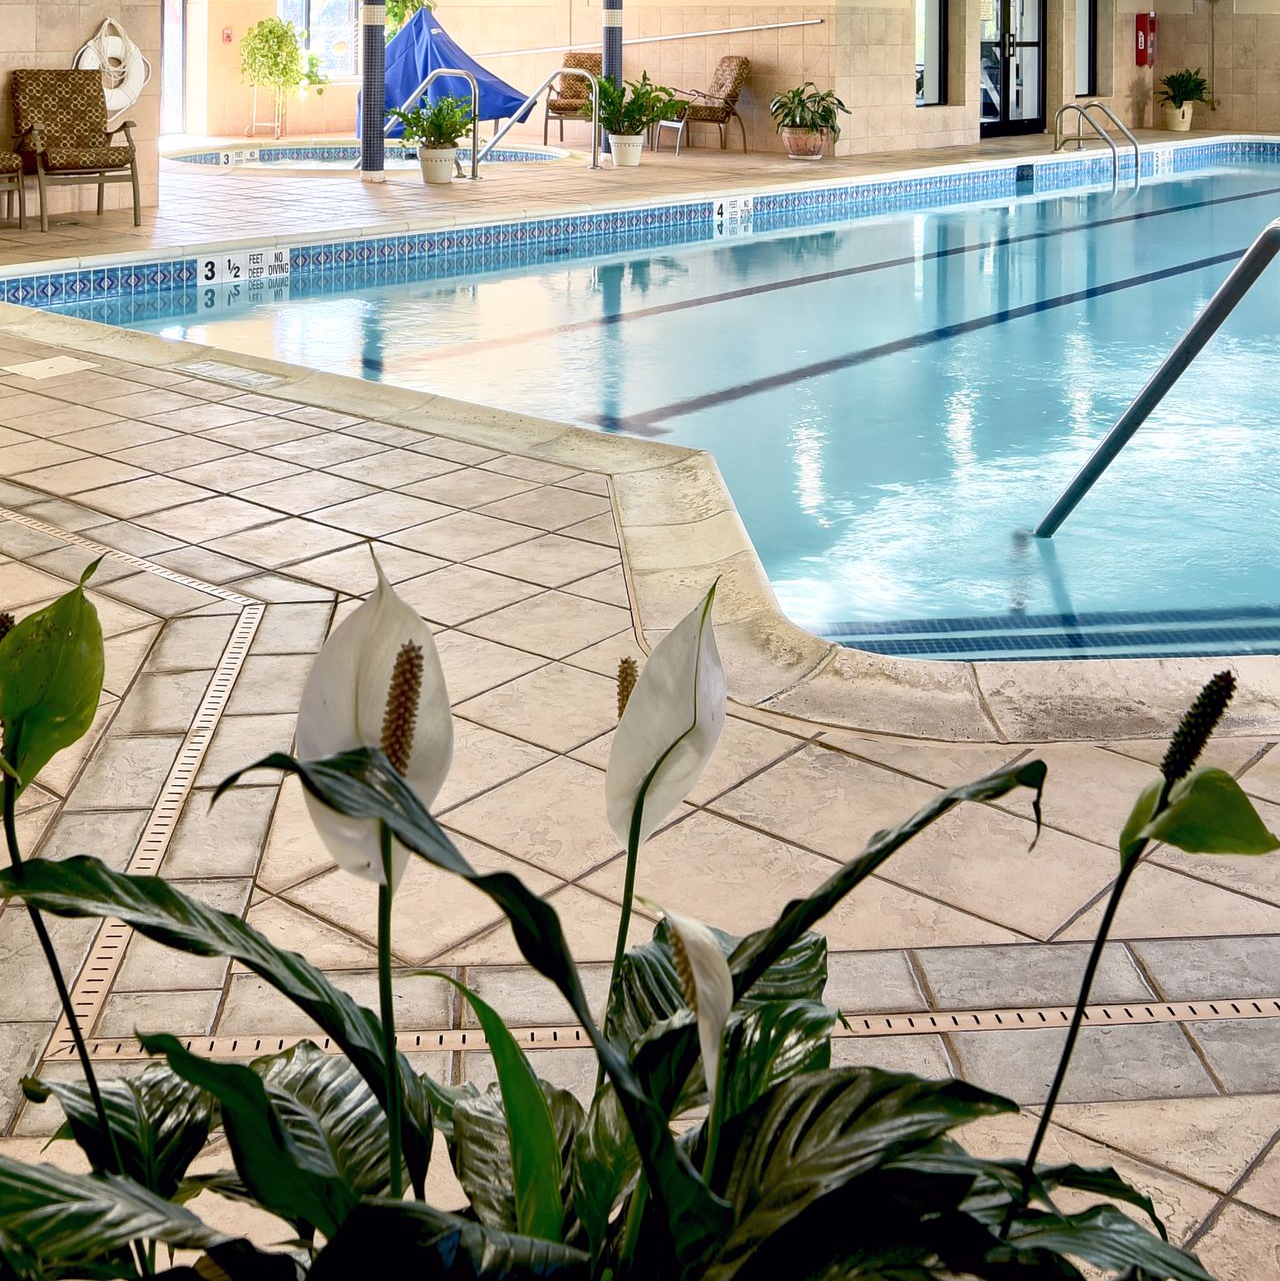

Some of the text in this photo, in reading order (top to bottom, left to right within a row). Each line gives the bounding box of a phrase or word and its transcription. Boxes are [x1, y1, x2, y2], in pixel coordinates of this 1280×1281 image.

[223, 153, 229, 165] 3
[717, 203, 723, 218] 4
[274, 252, 283, 263] NO
[205, 261, 215, 281] 3
[249, 254, 263, 264] FEET
[249, 268, 264, 278] DEEP
[269, 263, 289, 275] DIVING
